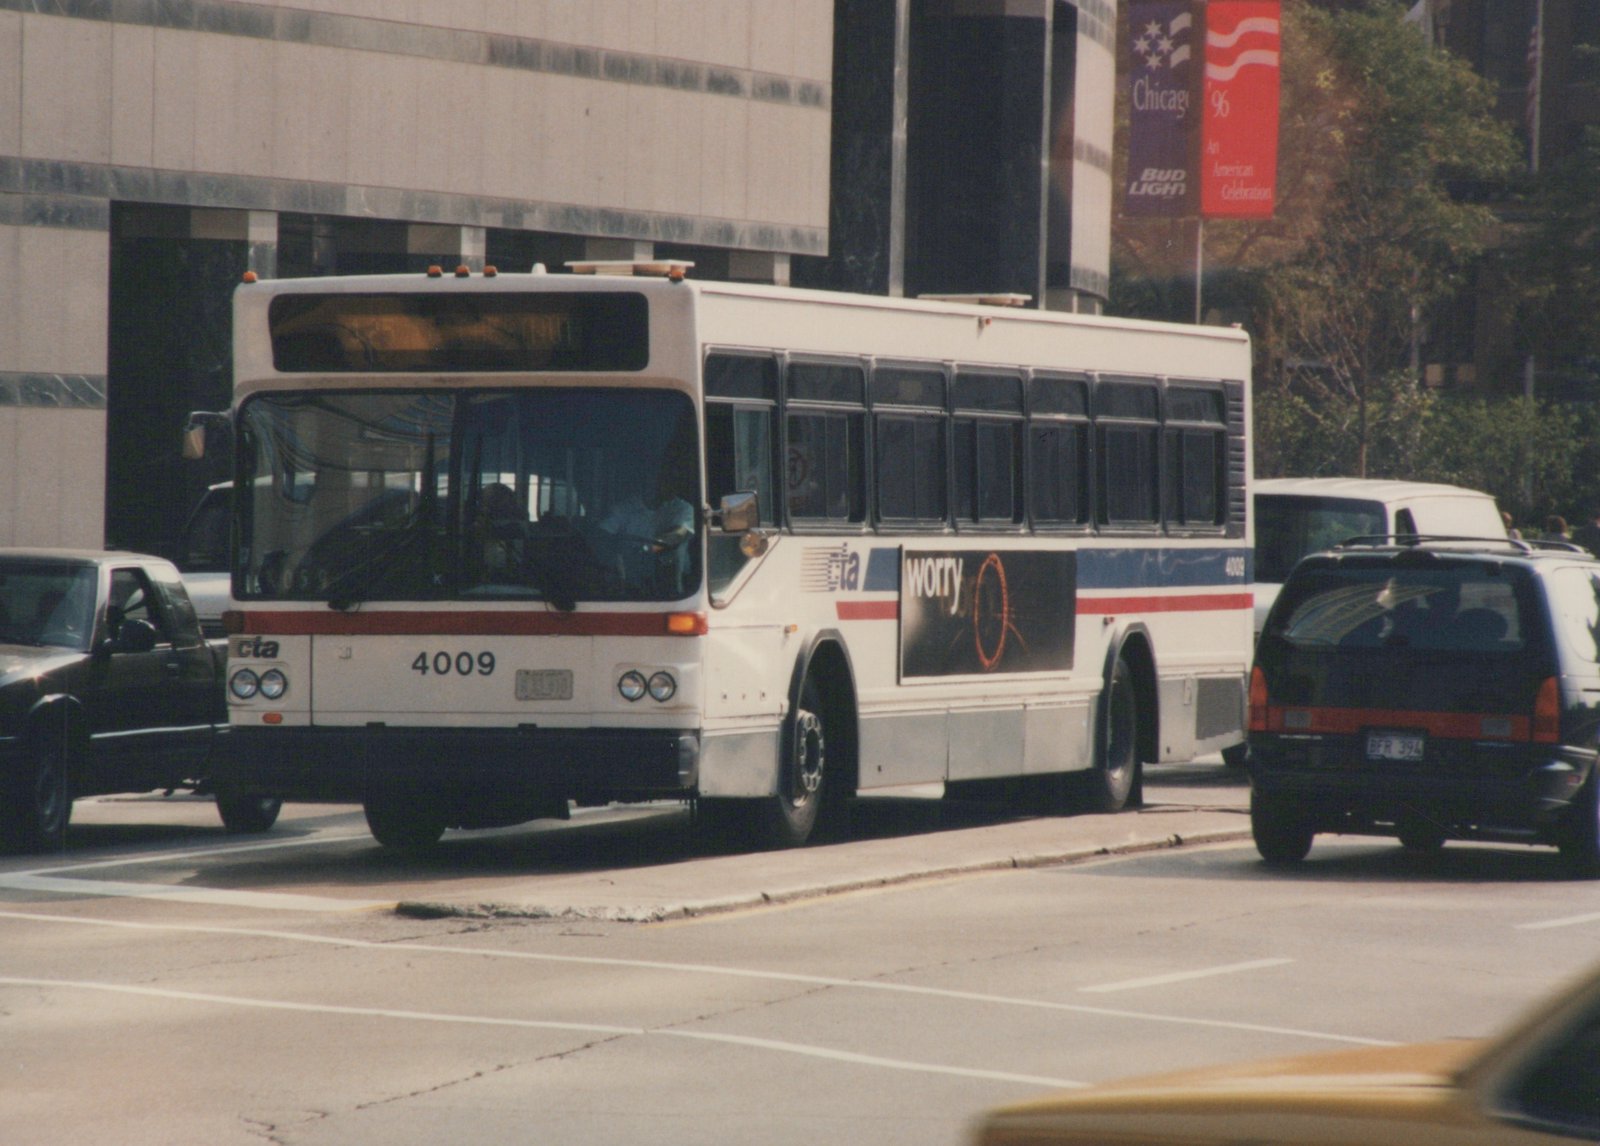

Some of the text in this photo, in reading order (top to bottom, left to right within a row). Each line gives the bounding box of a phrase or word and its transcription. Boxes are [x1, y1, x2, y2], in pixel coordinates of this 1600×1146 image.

[1141, 167, 1187, 182] BUD
[1213, 161, 1254, 176] American
[1221, 179, 1272, 200] Celebration
[1226, 556, 1245, 577] 4009
[907, 557, 963, 615] worry
[238, 636, 280, 659] cta
[412, 651, 496, 676] 4009
